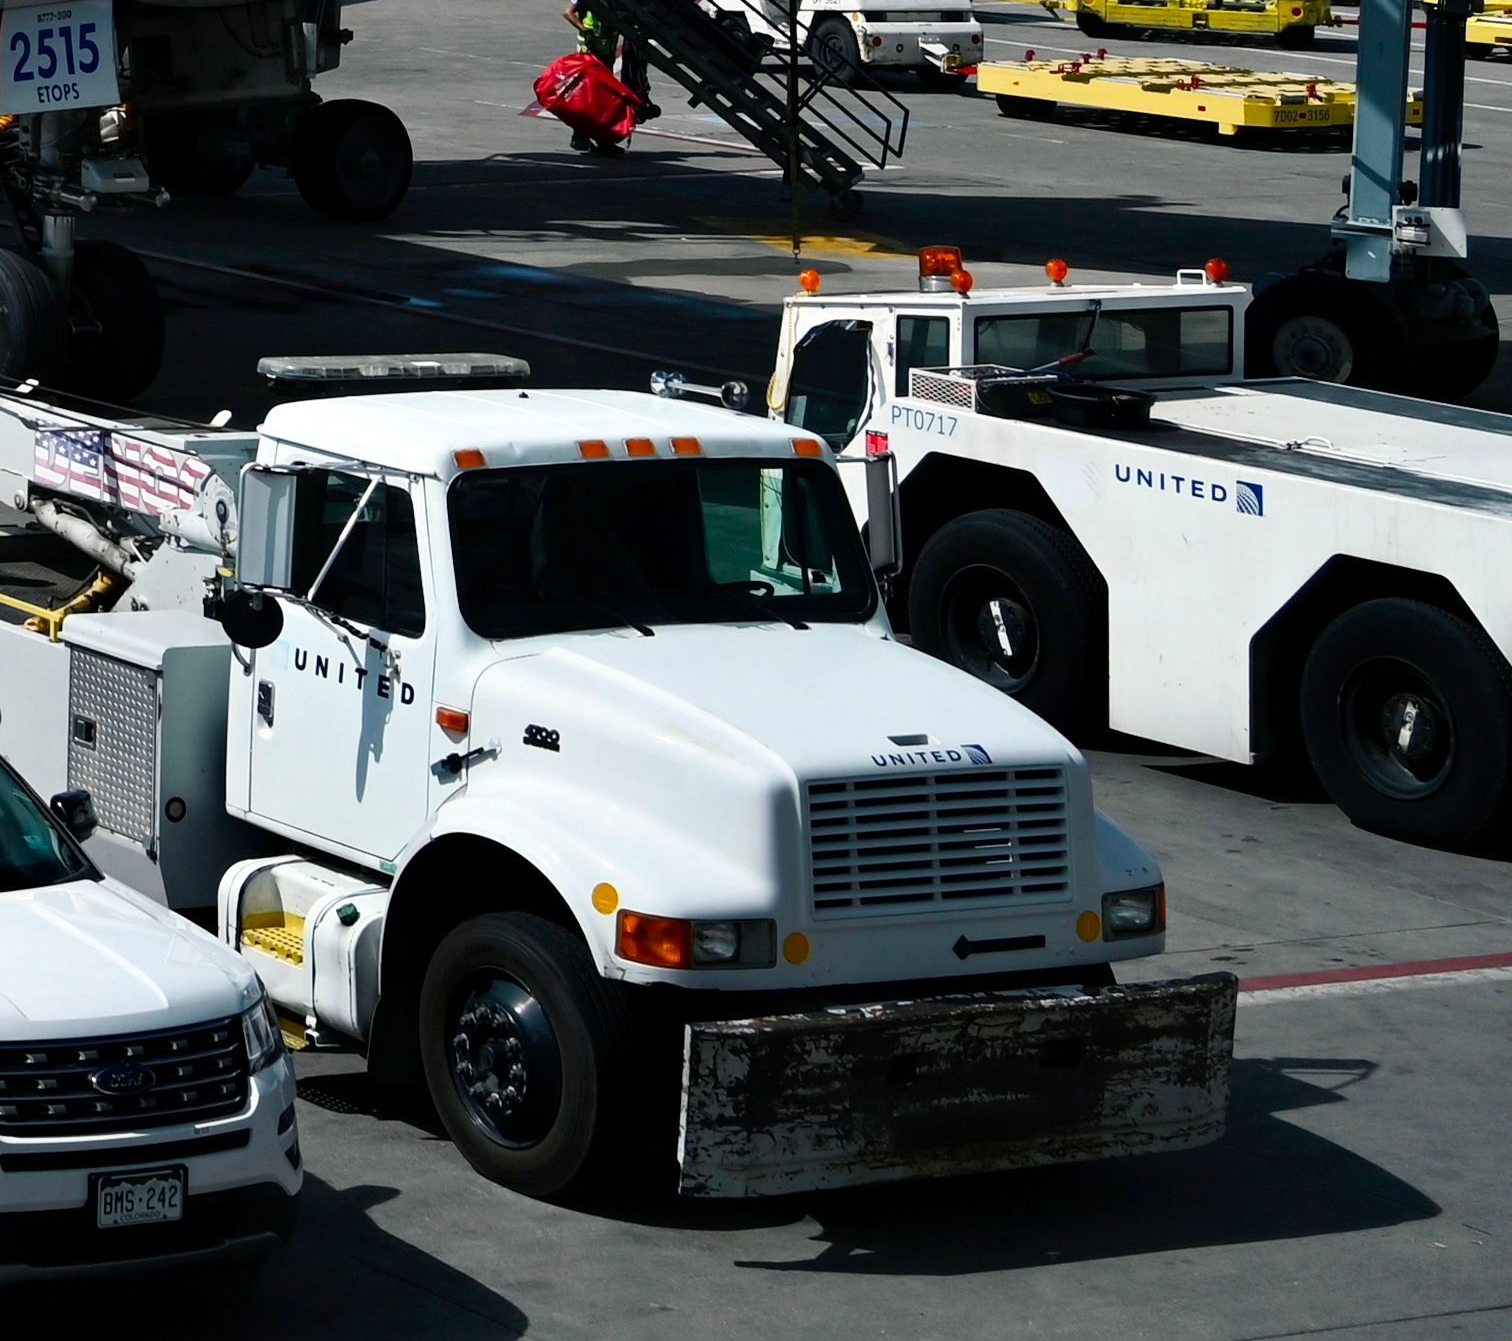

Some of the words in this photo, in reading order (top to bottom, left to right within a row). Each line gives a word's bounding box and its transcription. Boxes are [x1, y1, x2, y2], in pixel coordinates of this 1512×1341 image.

[10, 22, 100, 82] 2515
[37, 82, 80, 103] ETOPS
[891, 404, 958, 437] PT0717
[1115, 463, 1227, 503] UNITED
[294, 647, 415, 705] UNITED
[871, 749, 962, 767] UNITED
